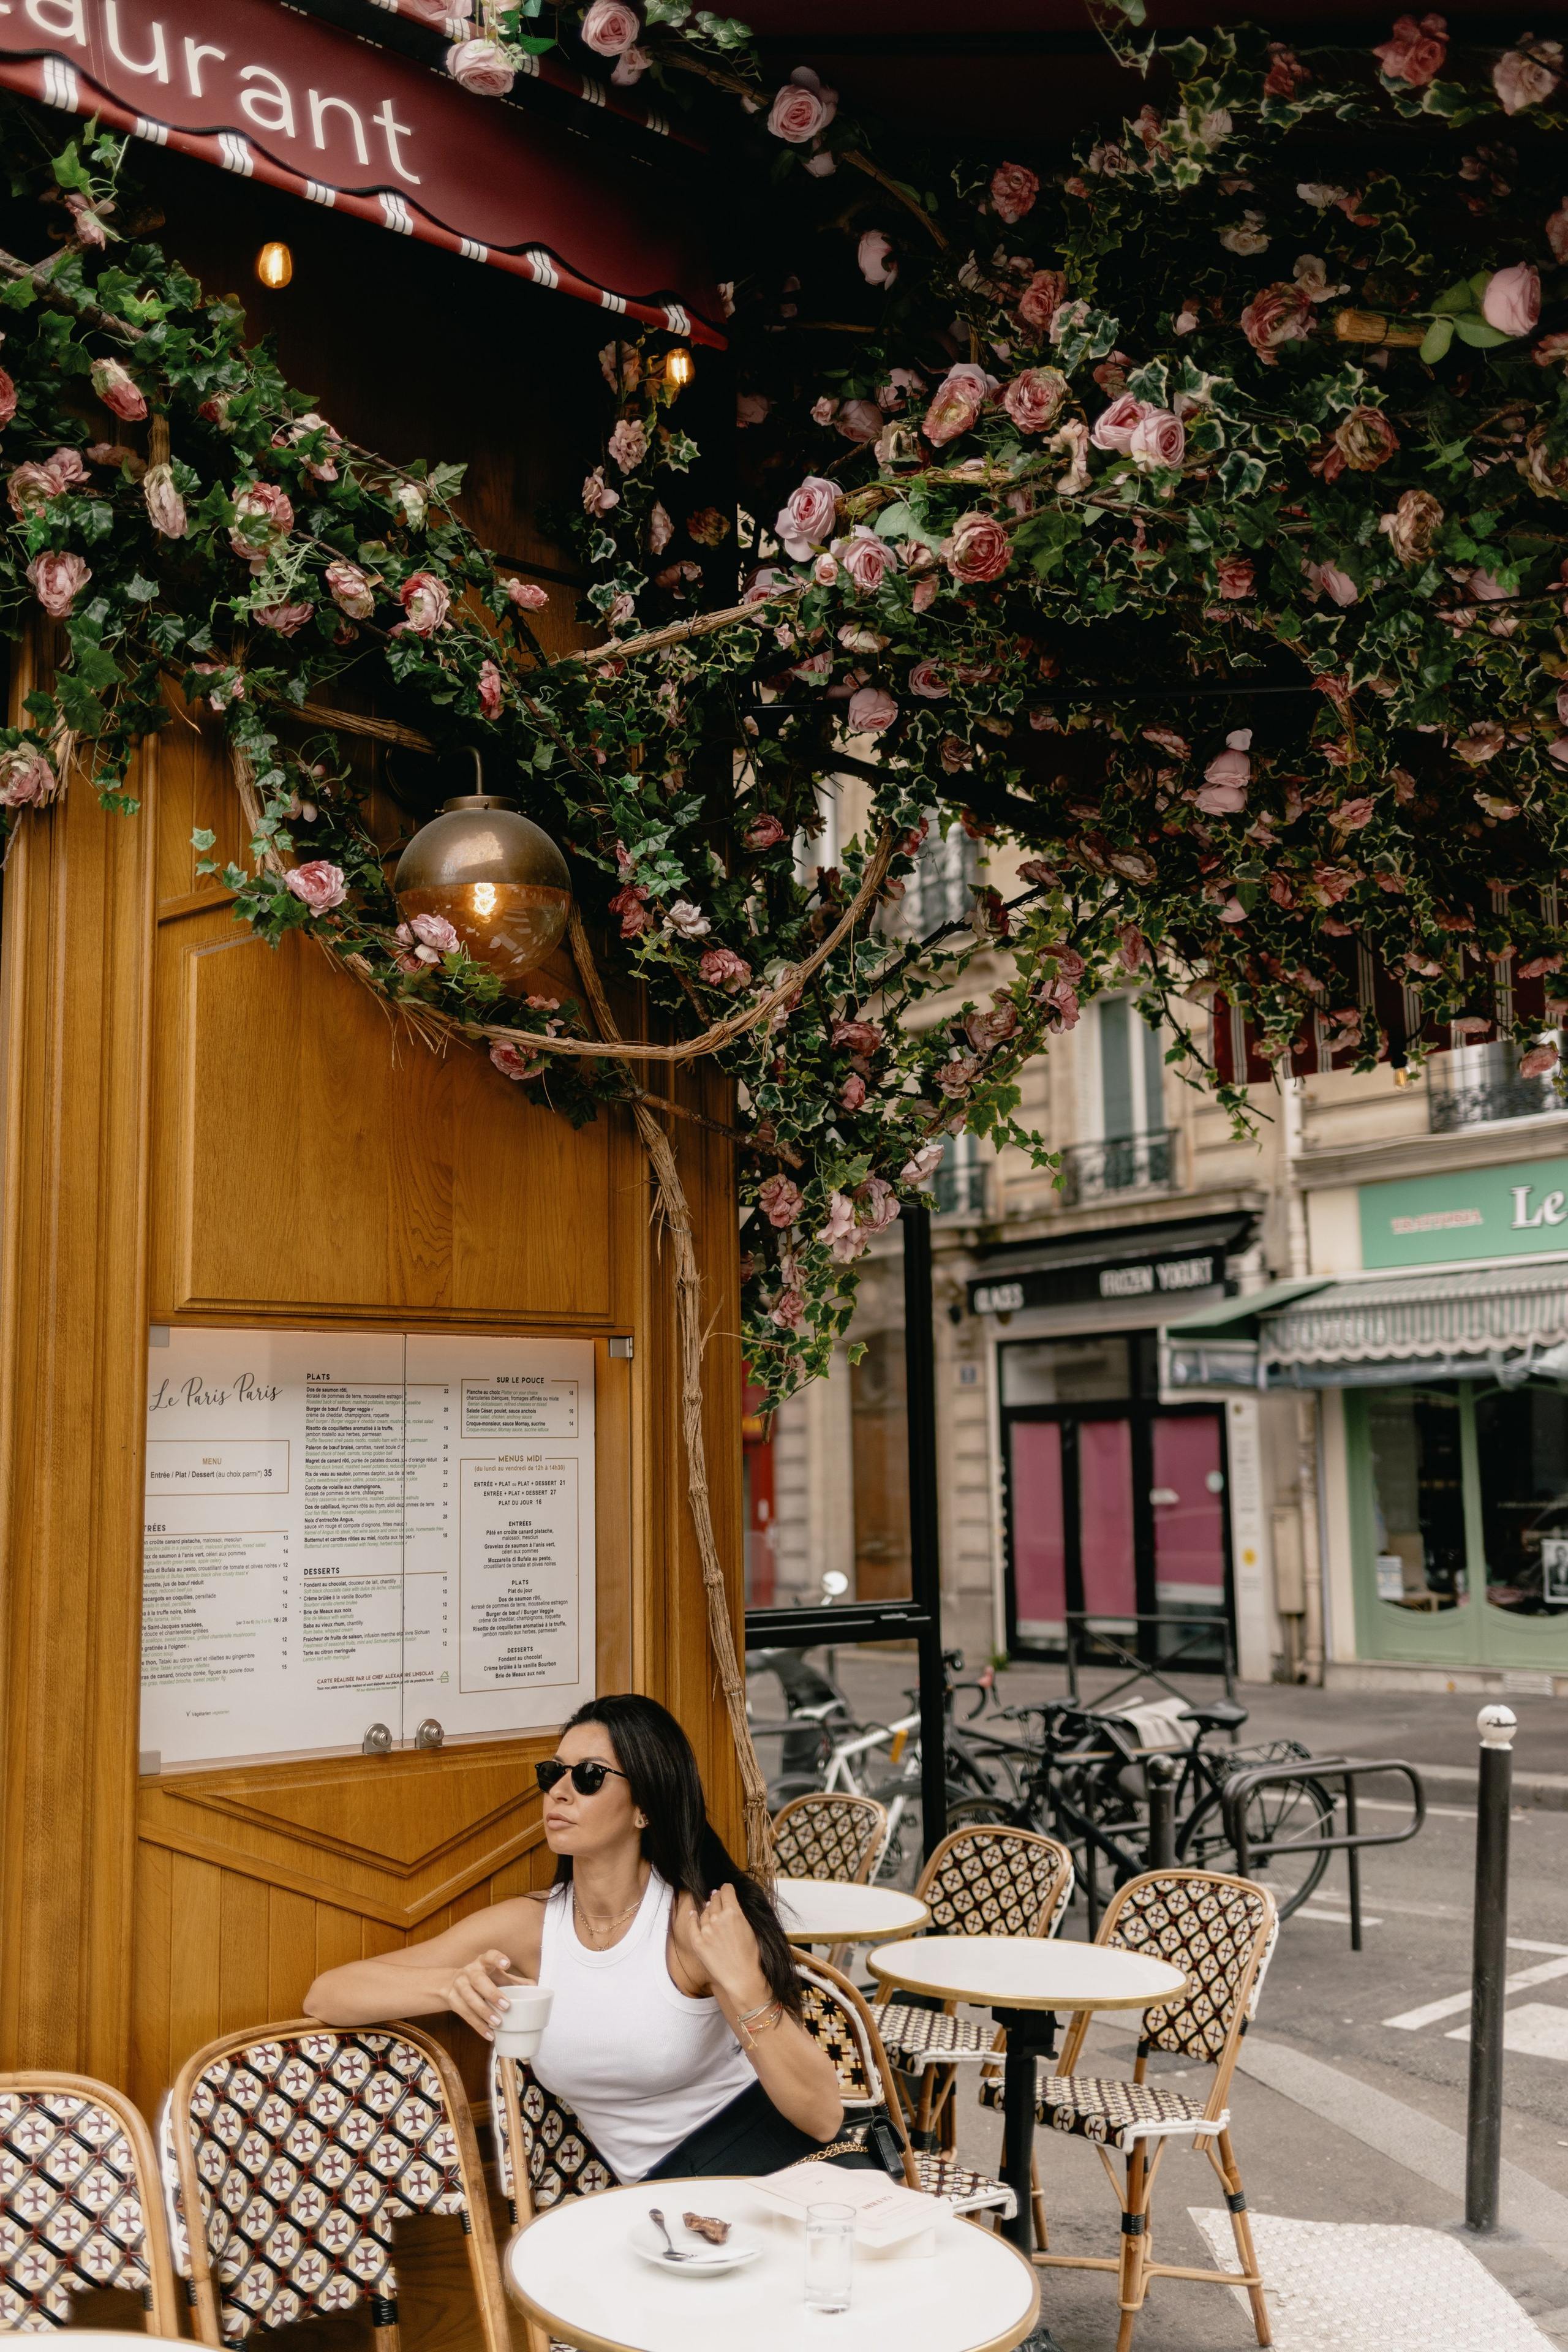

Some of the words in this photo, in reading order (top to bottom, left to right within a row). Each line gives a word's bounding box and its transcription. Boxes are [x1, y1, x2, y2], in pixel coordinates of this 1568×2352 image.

[0, 0, 421, 185] aurant
[1510, 1185, 1567, 1230] Le
[149, 1379, 179, 1411] Le
[181, 1377, 232, 1406] Paris
[233, 1373, 283, 1402] Paris
